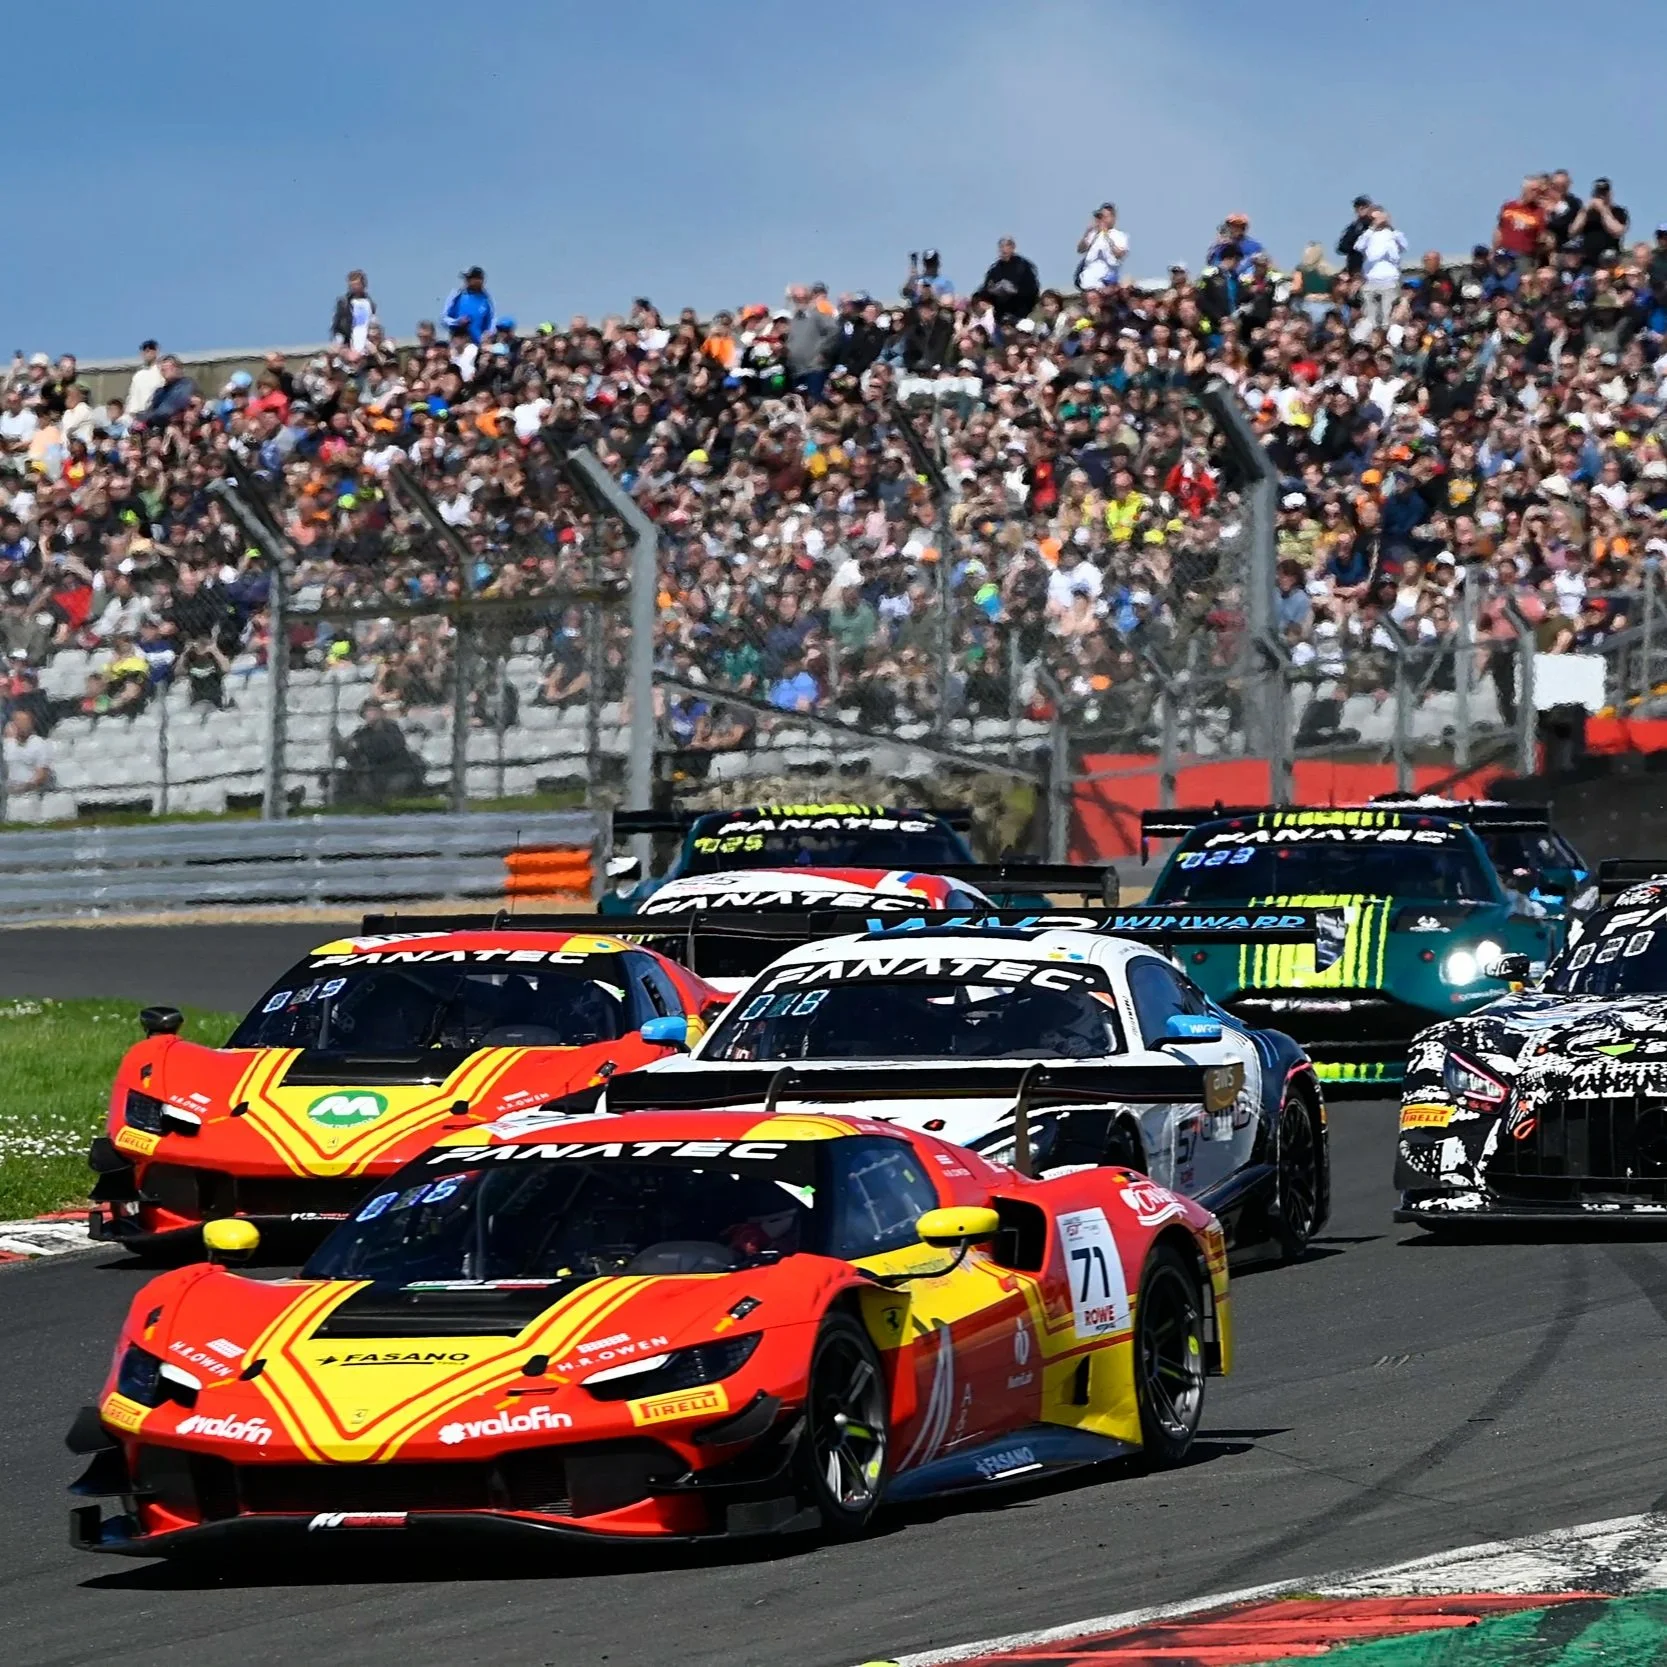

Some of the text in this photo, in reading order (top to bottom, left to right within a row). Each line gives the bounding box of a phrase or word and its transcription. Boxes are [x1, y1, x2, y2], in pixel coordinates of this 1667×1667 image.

[718, 817, 930, 835] FANATEC
[1205, 829, 1449, 847] FANATEC
[647, 891, 919, 915] FANATEC
[1113, 916, 1306, 930] WINWARD
[309, 950, 589, 968] FANATEC
[1567, 930, 1655, 970] 020
[763, 958, 1085, 993] FANATEC
[738, 990, 830, 1021] 018
[1402, 1108, 1448, 1123] PIRELLI
[427, 1142, 788, 1164] FANATEC
[1071, 1246, 1110, 1302] 71
[1084, 1304, 1115, 1326] ROWE
[343, 1353, 470, 1362] FASANO
[639, 1391, 719, 1419] PIRELLI
[982, 1446, 1035, 1472] FASANO
